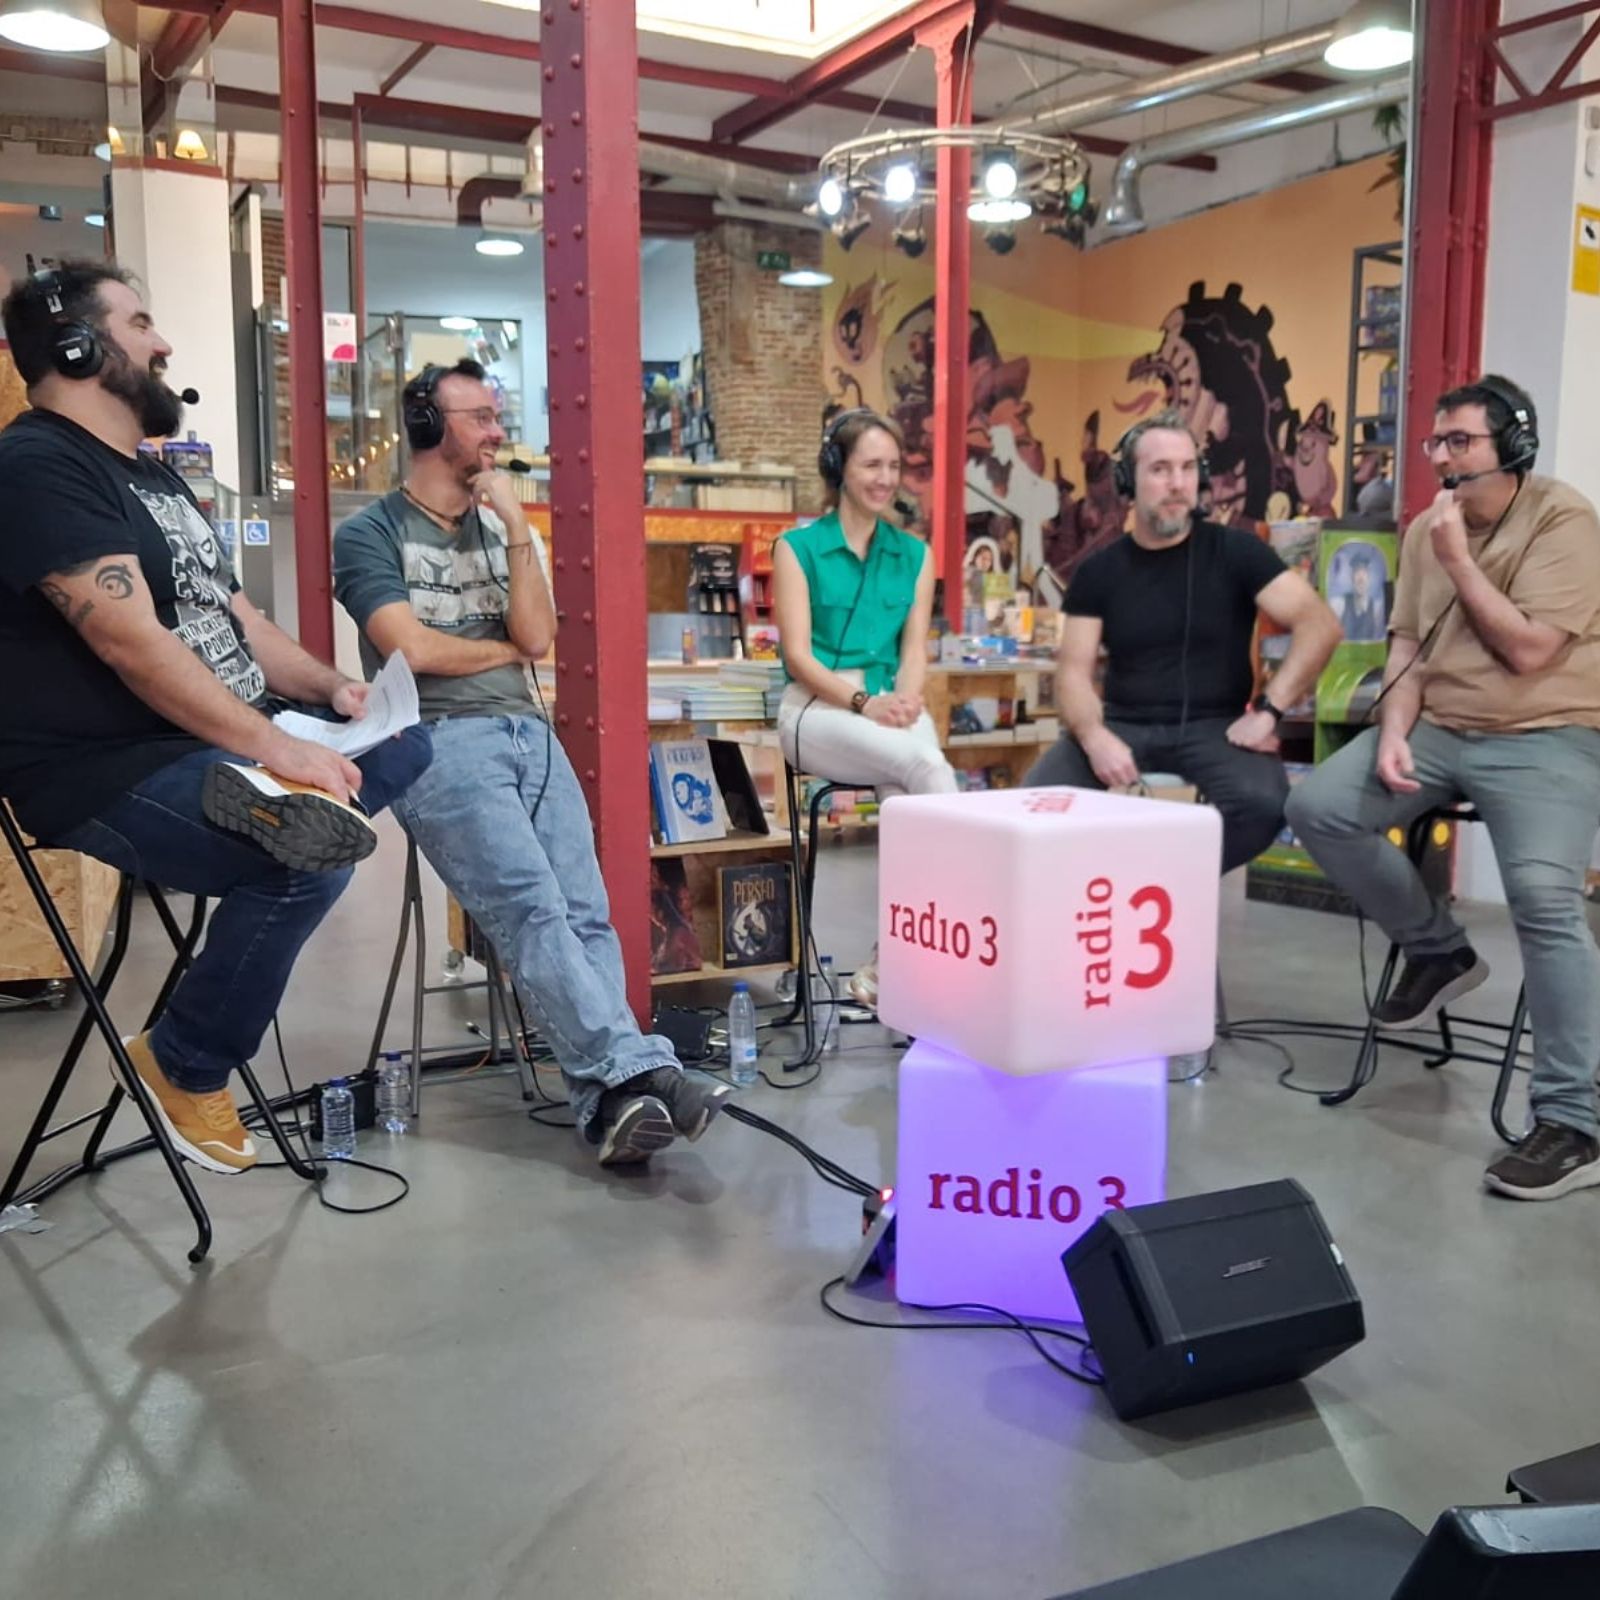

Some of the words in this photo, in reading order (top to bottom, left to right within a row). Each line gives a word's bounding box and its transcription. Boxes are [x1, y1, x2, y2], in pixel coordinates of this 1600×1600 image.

[203, 627, 236, 658] POWER
[890, 902, 971, 960] radio
[978, 916, 999, 968] 3
[1076, 877, 1114, 1009] radio
[1124, 885, 1174, 990] 3
[928, 1167, 1083, 1225] radio
